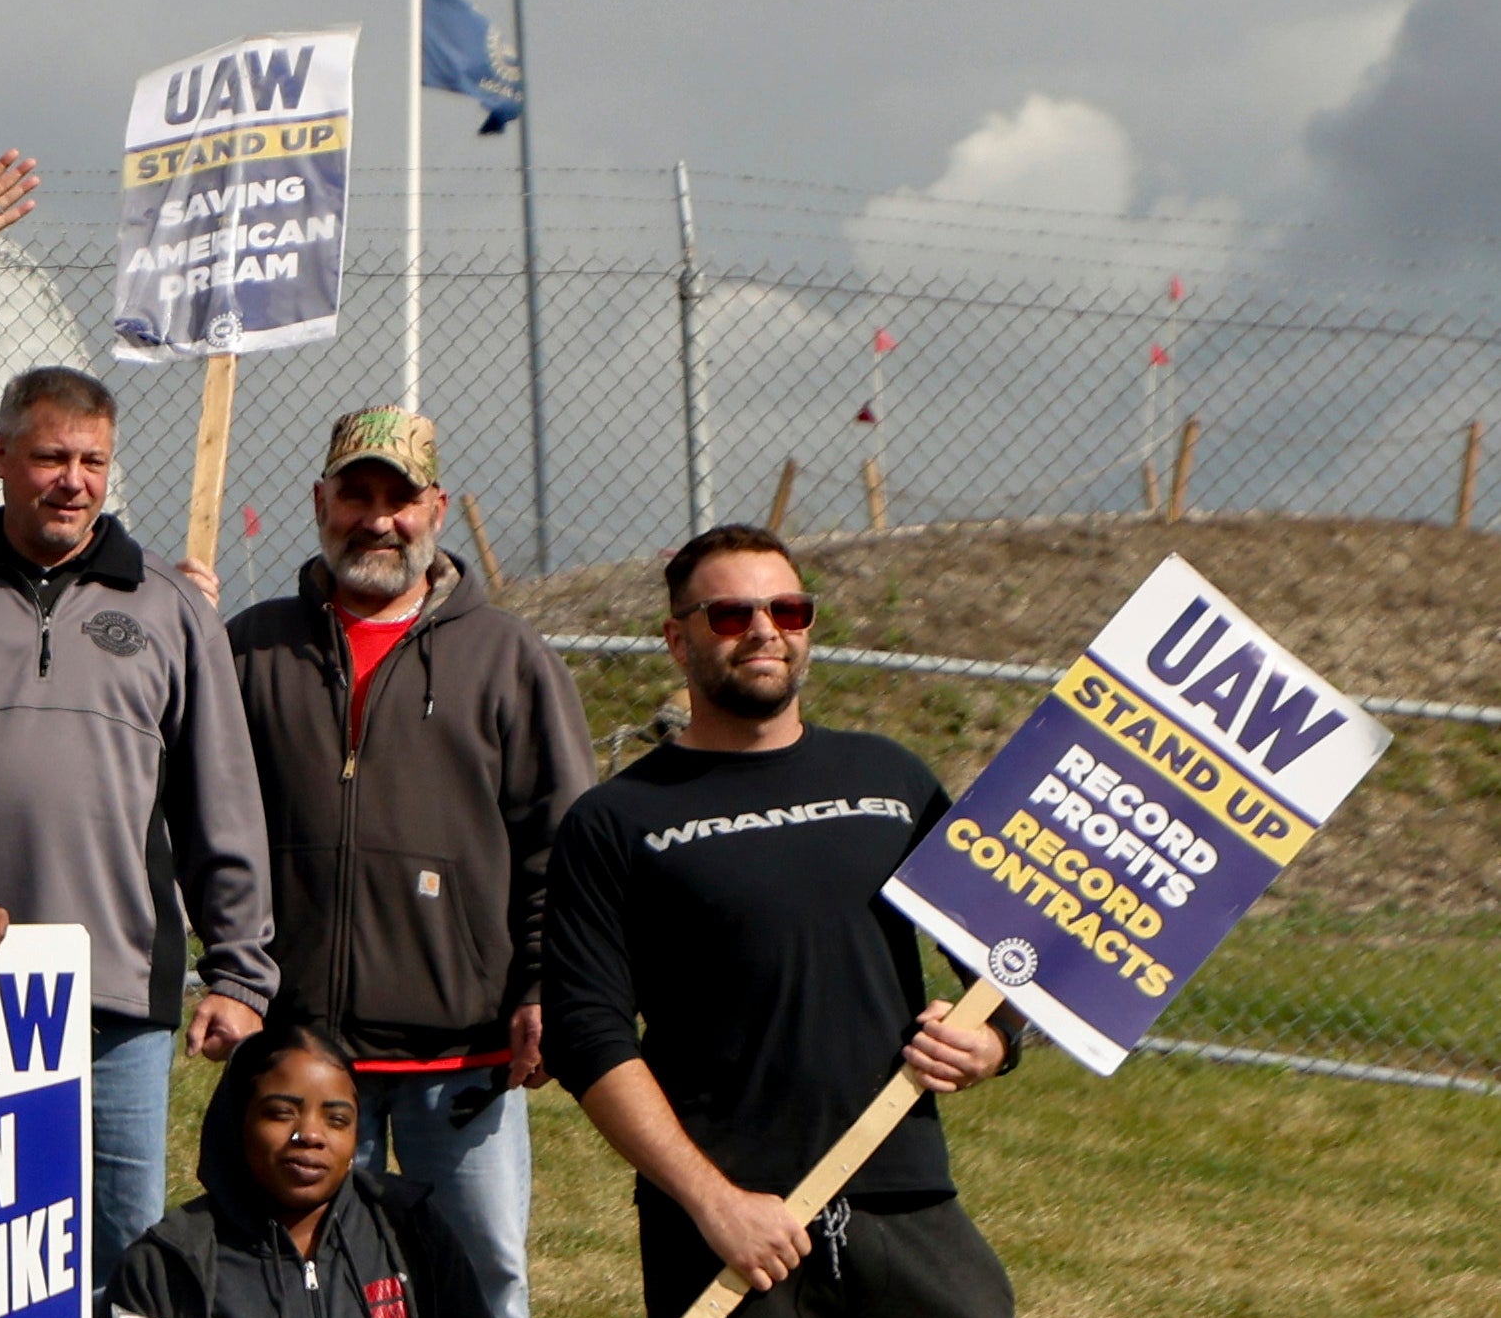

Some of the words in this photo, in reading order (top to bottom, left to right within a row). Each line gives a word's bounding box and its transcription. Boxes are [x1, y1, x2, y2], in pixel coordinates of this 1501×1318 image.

[164, 44, 315, 125] UAW
[136, 132, 268, 180] STAND
[280, 124, 335, 151] UP
[159, 176, 306, 227] SAVING
[125, 213, 337, 274] AMERICAN
[158, 251, 298, 302] DREAM
[1146, 594, 1349, 776] UAW
[1055, 743, 1219, 876] RECORD
[1073, 674, 1221, 793] STAND
[1226, 786, 1291, 844] UP
[645, 797, 914, 852] WRANGLER
[1001, 809, 1165, 941] RECORD
[1029, 774, 1196, 908] PROFITS
[945, 818, 1177, 999] CONTRACTS
